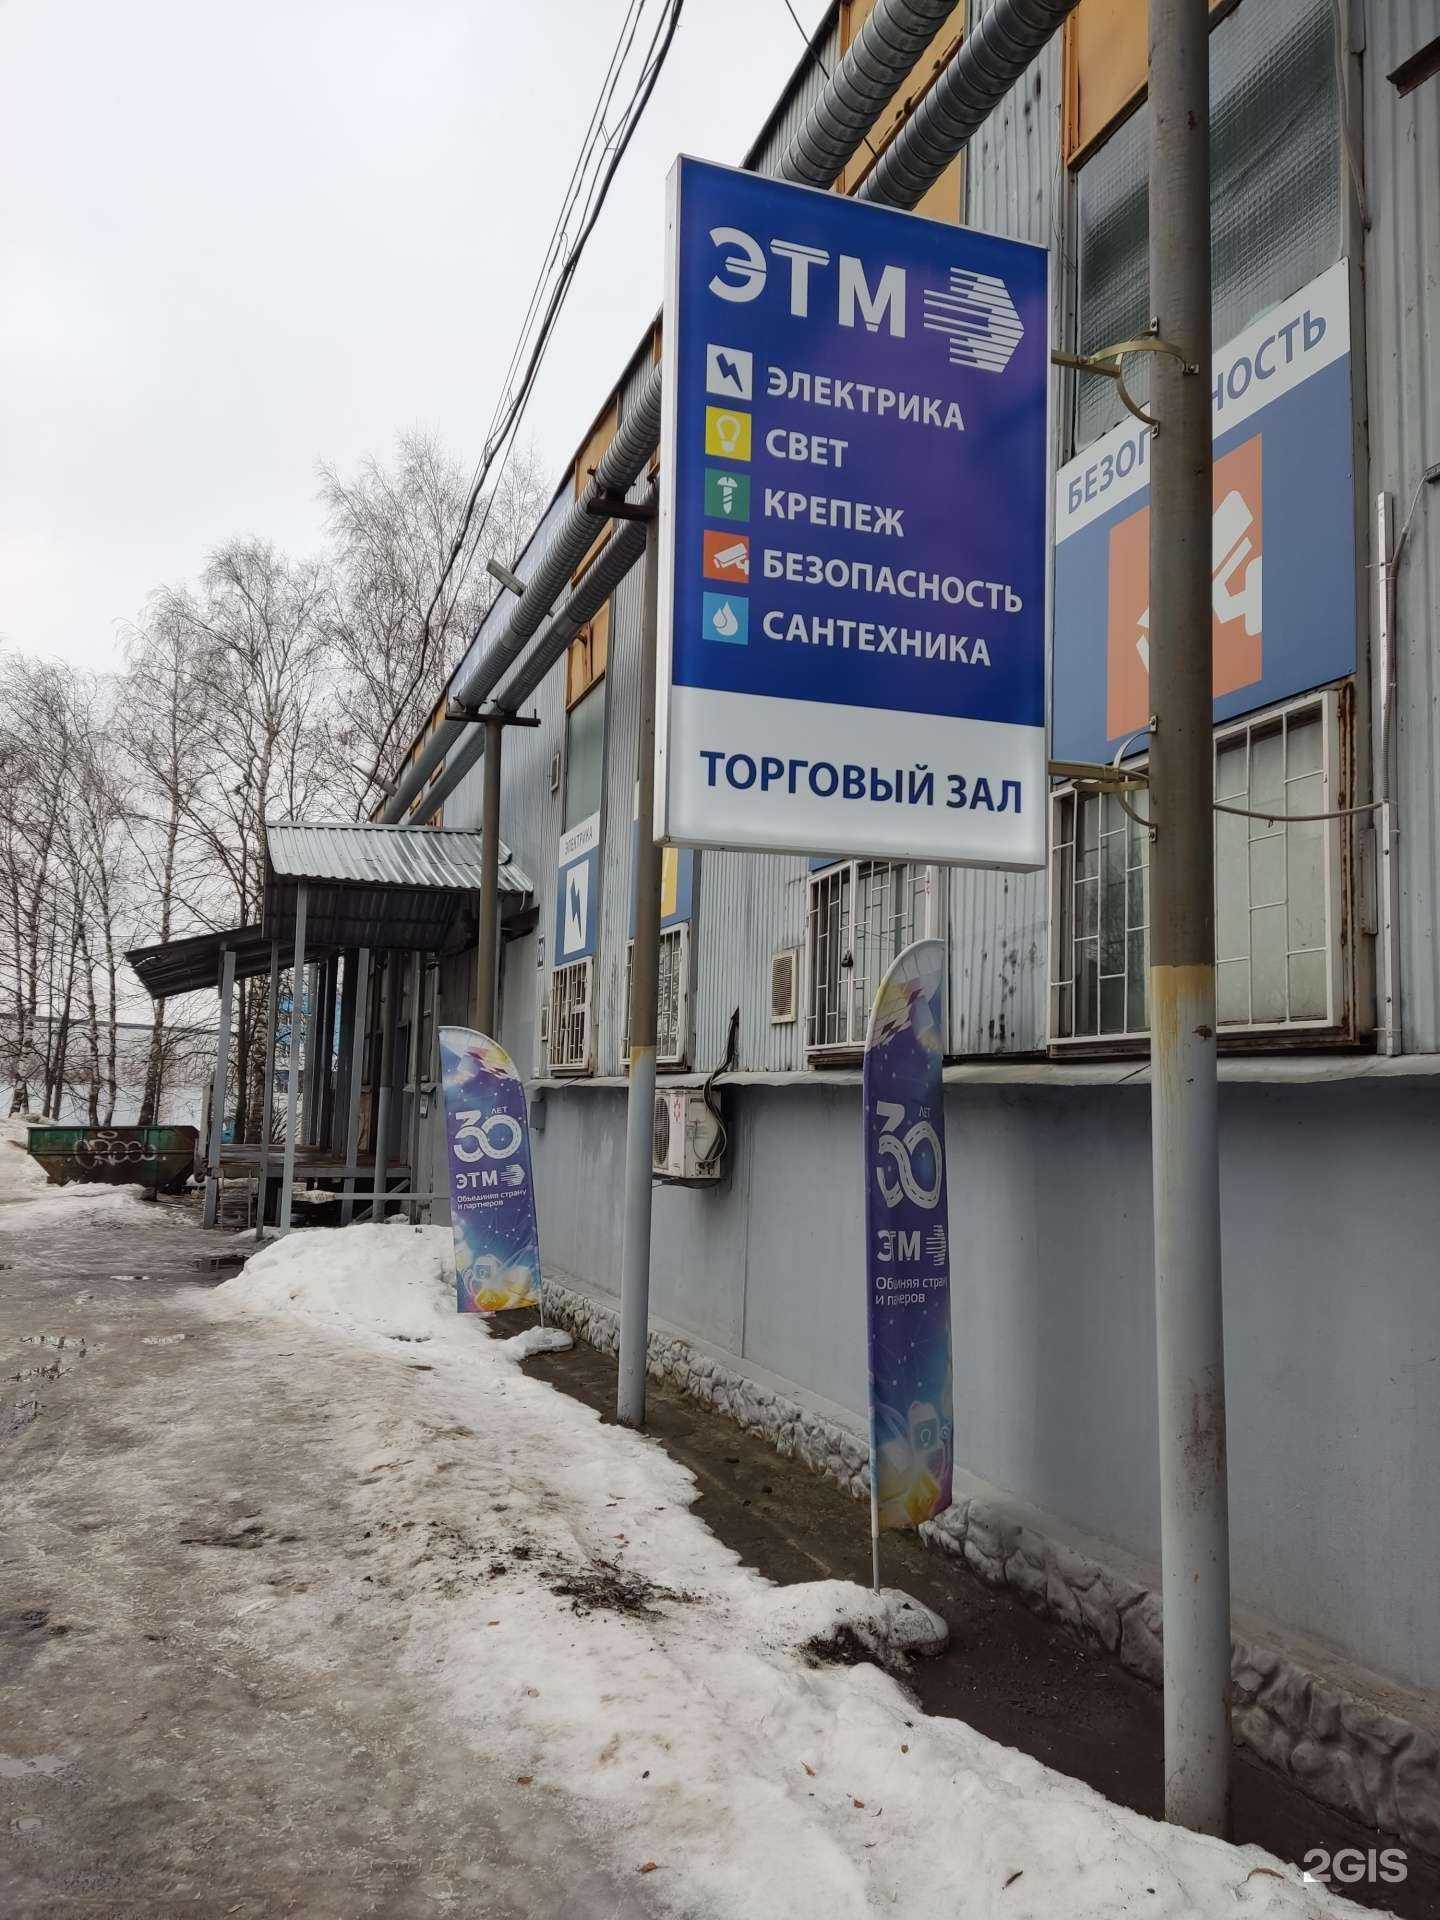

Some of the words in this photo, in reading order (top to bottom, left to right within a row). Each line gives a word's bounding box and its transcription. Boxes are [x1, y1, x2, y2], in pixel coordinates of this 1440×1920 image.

[708, 226, 906, 338] ЭТМ
[766, 366, 965, 431] ЭЛЕКТРИКА
[1067, 310, 1327, 514] БЕЗОПНОСТЬ
[765, 428, 849, 468] СВЕТ
[763, 487, 905, 537] КРЕПЕЖ
[763, 549, 1023, 613] БЕЗОПАСНОСТЬ
[762, 611, 992, 667] САНТЕХНИКА
[699, 750, 935, 806] ТОРГОВЫЙ
[945, 774, 1023, 814] ЗАЛ
[453, 1109, 522, 1163] 30
[490, 1105, 508, 1115] ЛЕТ
[876, 1100, 943, 1209] 30
[455, 1169, 499, 1190] ЭТМ
